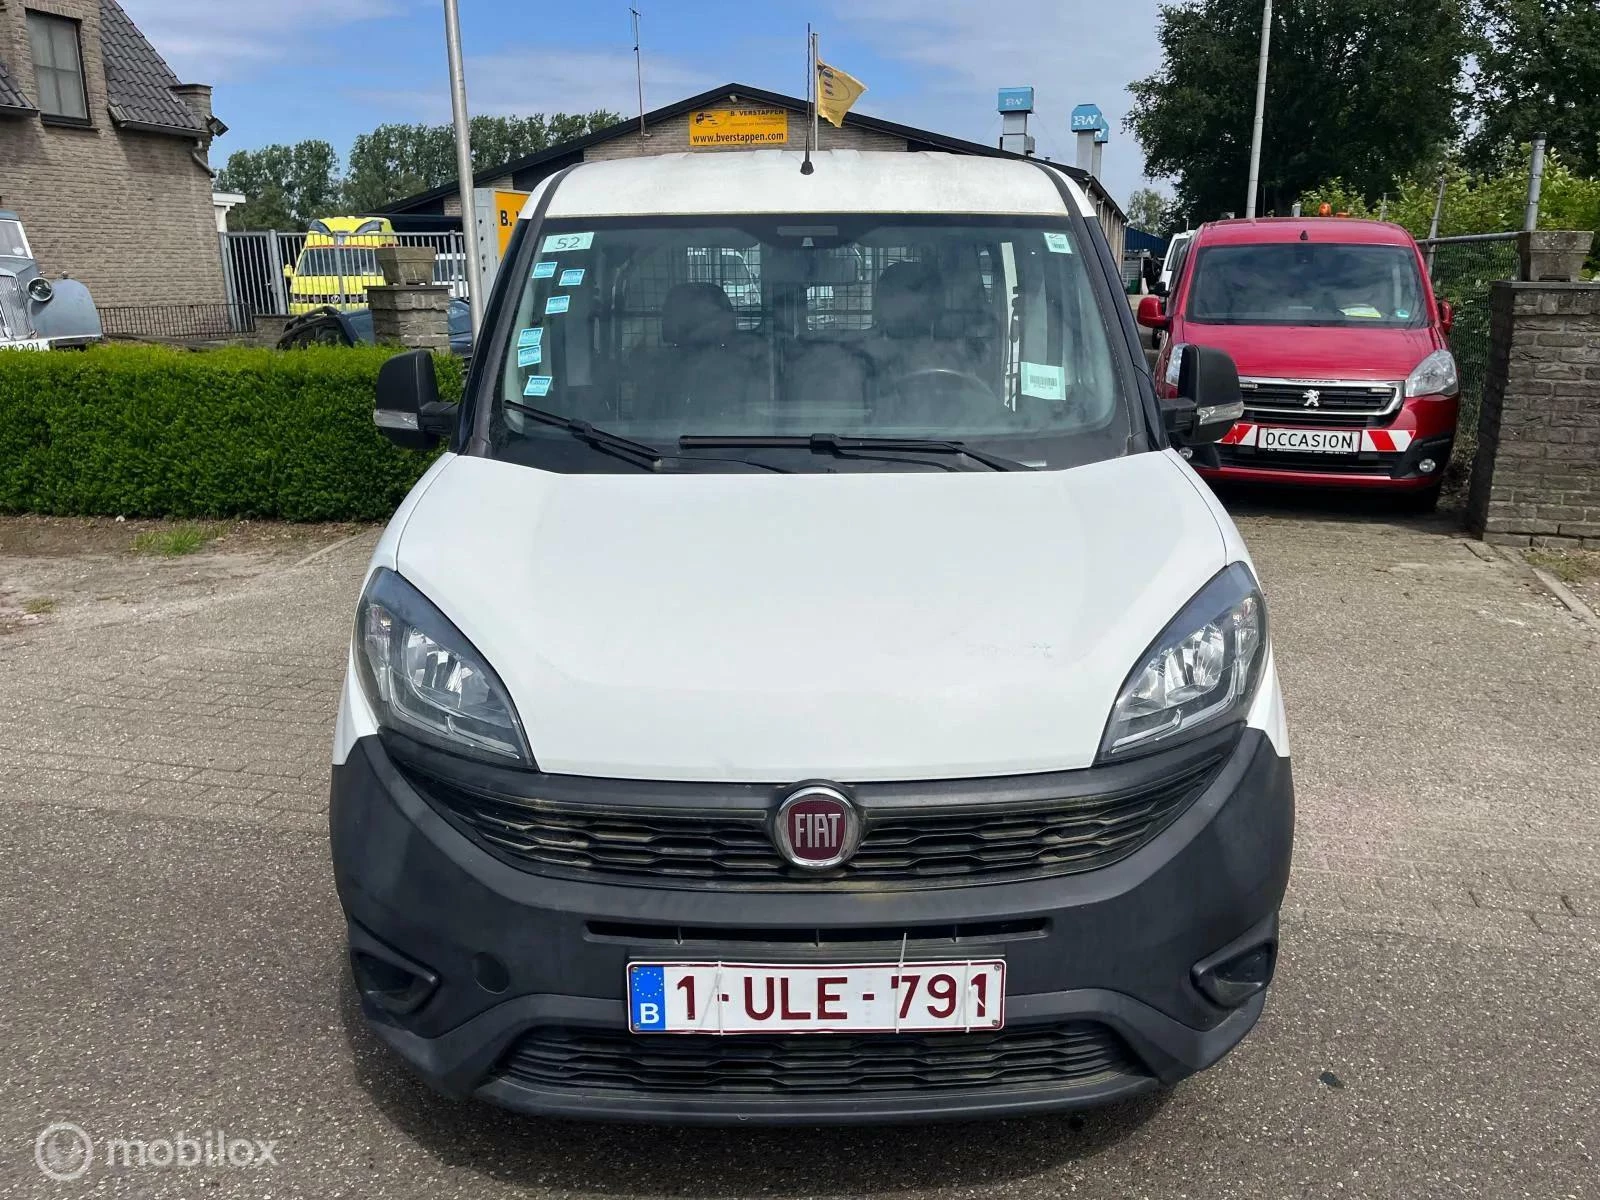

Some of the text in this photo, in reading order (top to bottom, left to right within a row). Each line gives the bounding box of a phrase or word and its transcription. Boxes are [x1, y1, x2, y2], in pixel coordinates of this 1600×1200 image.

[693, 132, 784, 144] www.bverstappen.com
[500, 210, 513, 227] B.
[1266, 432, 1353, 449] OCCASION
[795, 813, 841, 848] FIAT
[640, 1002, 660, 1024] B
